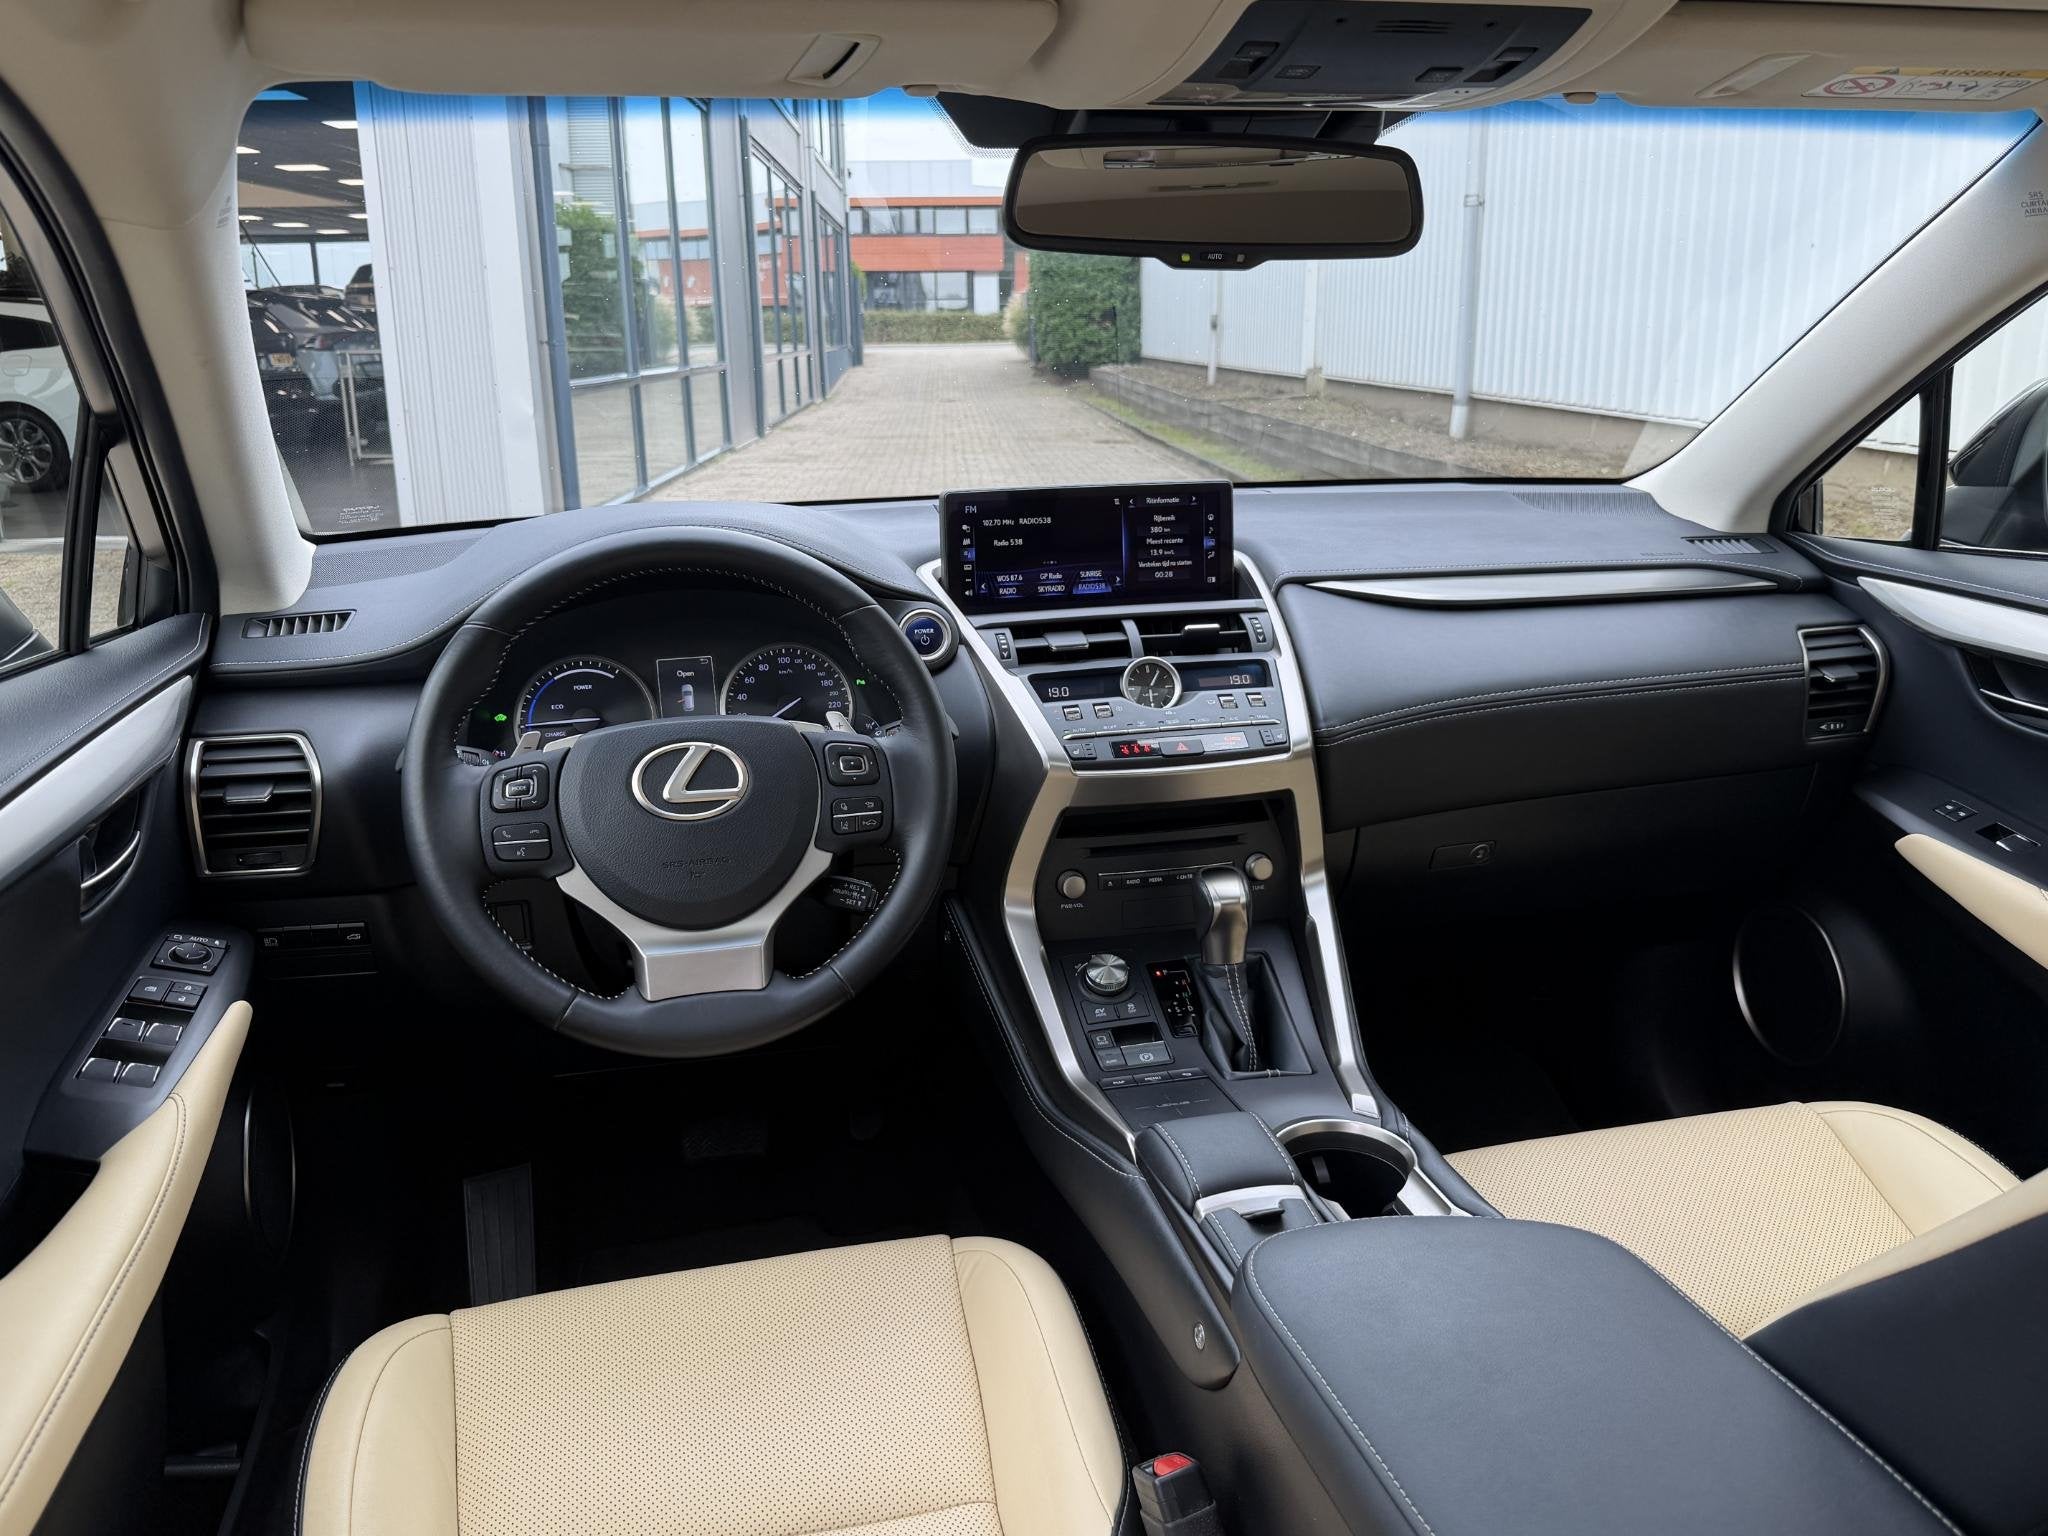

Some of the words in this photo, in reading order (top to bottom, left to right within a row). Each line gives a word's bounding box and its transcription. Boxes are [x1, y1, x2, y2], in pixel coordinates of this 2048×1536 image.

[2027, 191, 2044, 199] SRS
[964, 505, 977, 514] FM
[1018, 516, 1052, 525] RADIO538
[1150, 526, 1163, 534] 380
[993, 539, 1009, 547] Radio
[1009, 538, 1023, 546] 538
[1010, 574, 1023, 582] 87.6
[1079, 570, 1103, 578] SUNRISE
[1037, 585, 1066, 593] SKYRADIO
[1078, 583, 1106, 591] RADIO538
[758, 663, 769, 671] 80
[803, 663, 817, 671] 140
[676, 670, 695, 678] Open
[744, 676, 755, 684] 60
[1230, 674, 1250, 685] 19.0
[1048, 686, 1070, 698] 19.0
[737, 693, 748, 701] 40
[828, 701, 841, 709] 220
